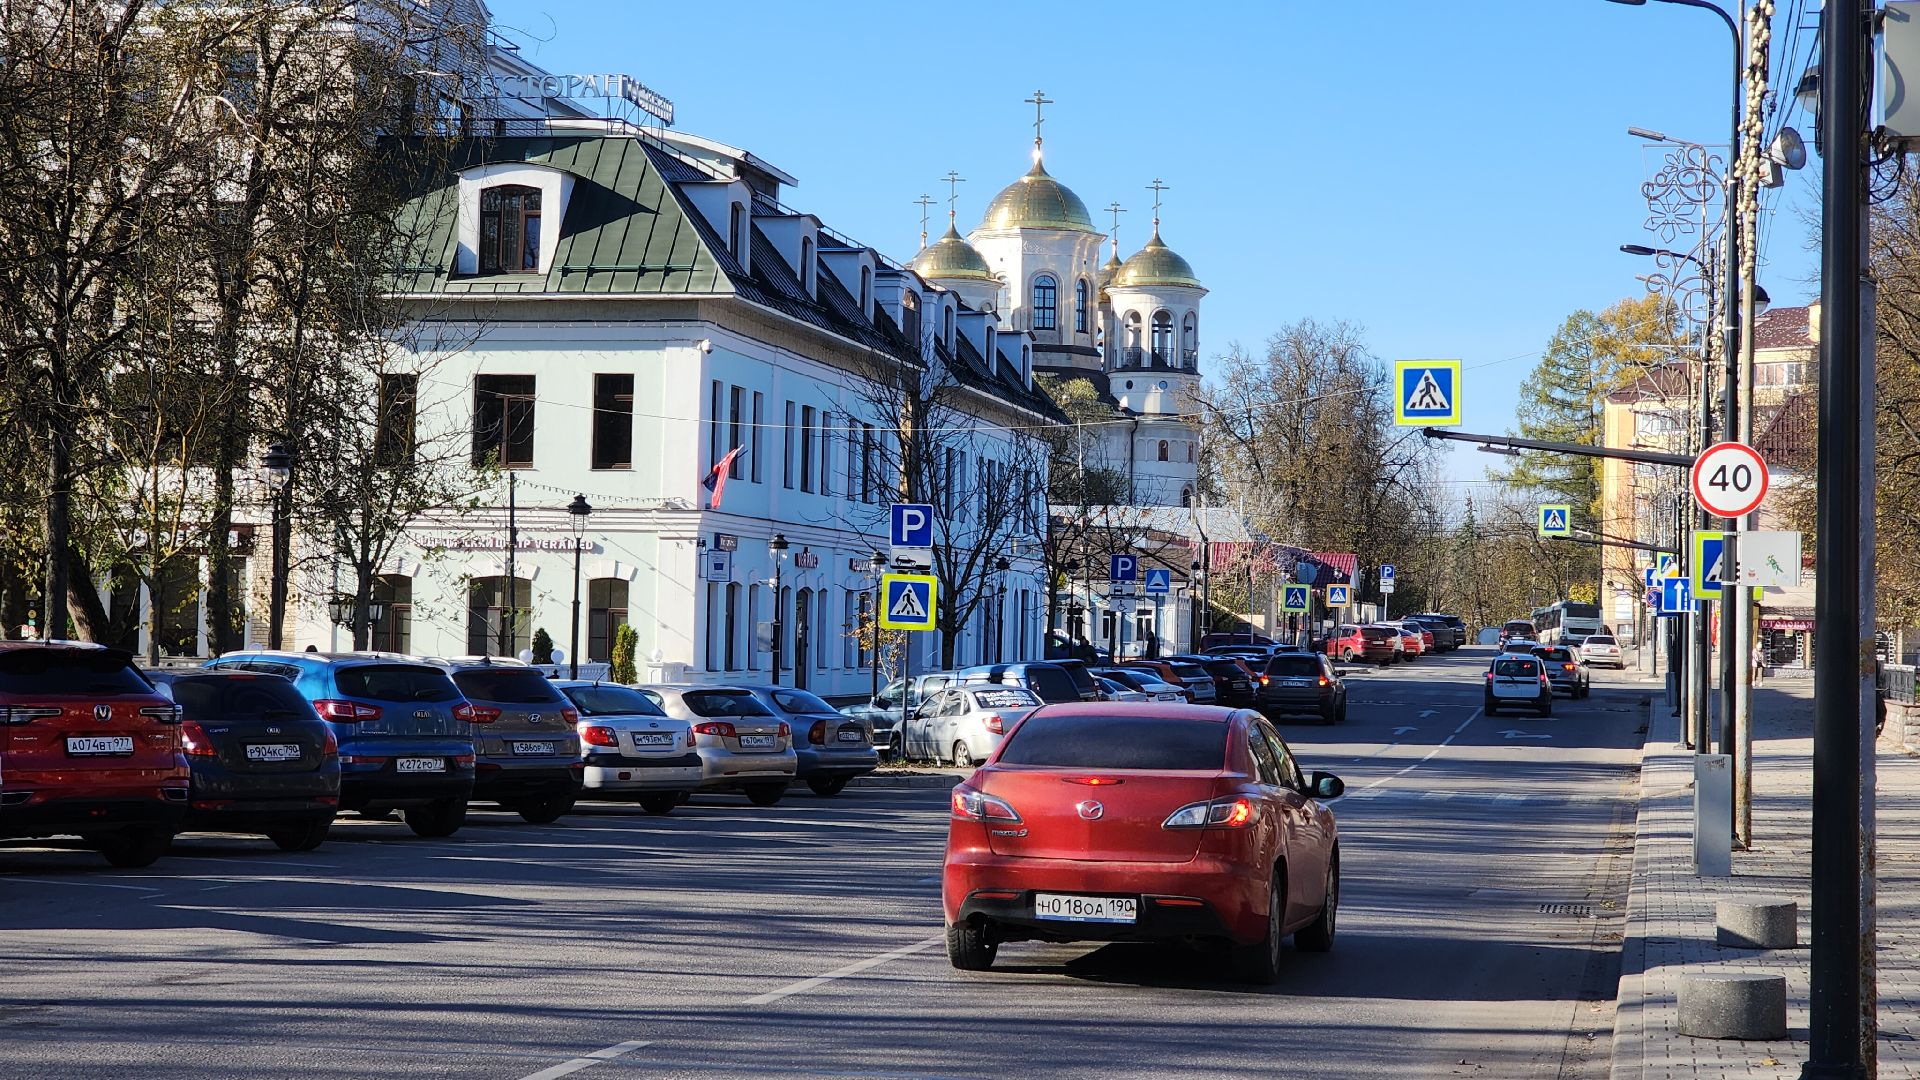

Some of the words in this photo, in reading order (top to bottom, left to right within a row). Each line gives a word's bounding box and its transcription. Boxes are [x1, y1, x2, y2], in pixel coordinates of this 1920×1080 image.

[1709, 464, 1752, 492] 40
[902, 509, 926, 542] P
[536, 537, 594, 550] VERAMED
[1117, 557, 1133, 578] P
[1384, 566, 1392, 578] P
[1761, 620, 1813, 630] СТОЛОВАЯ
